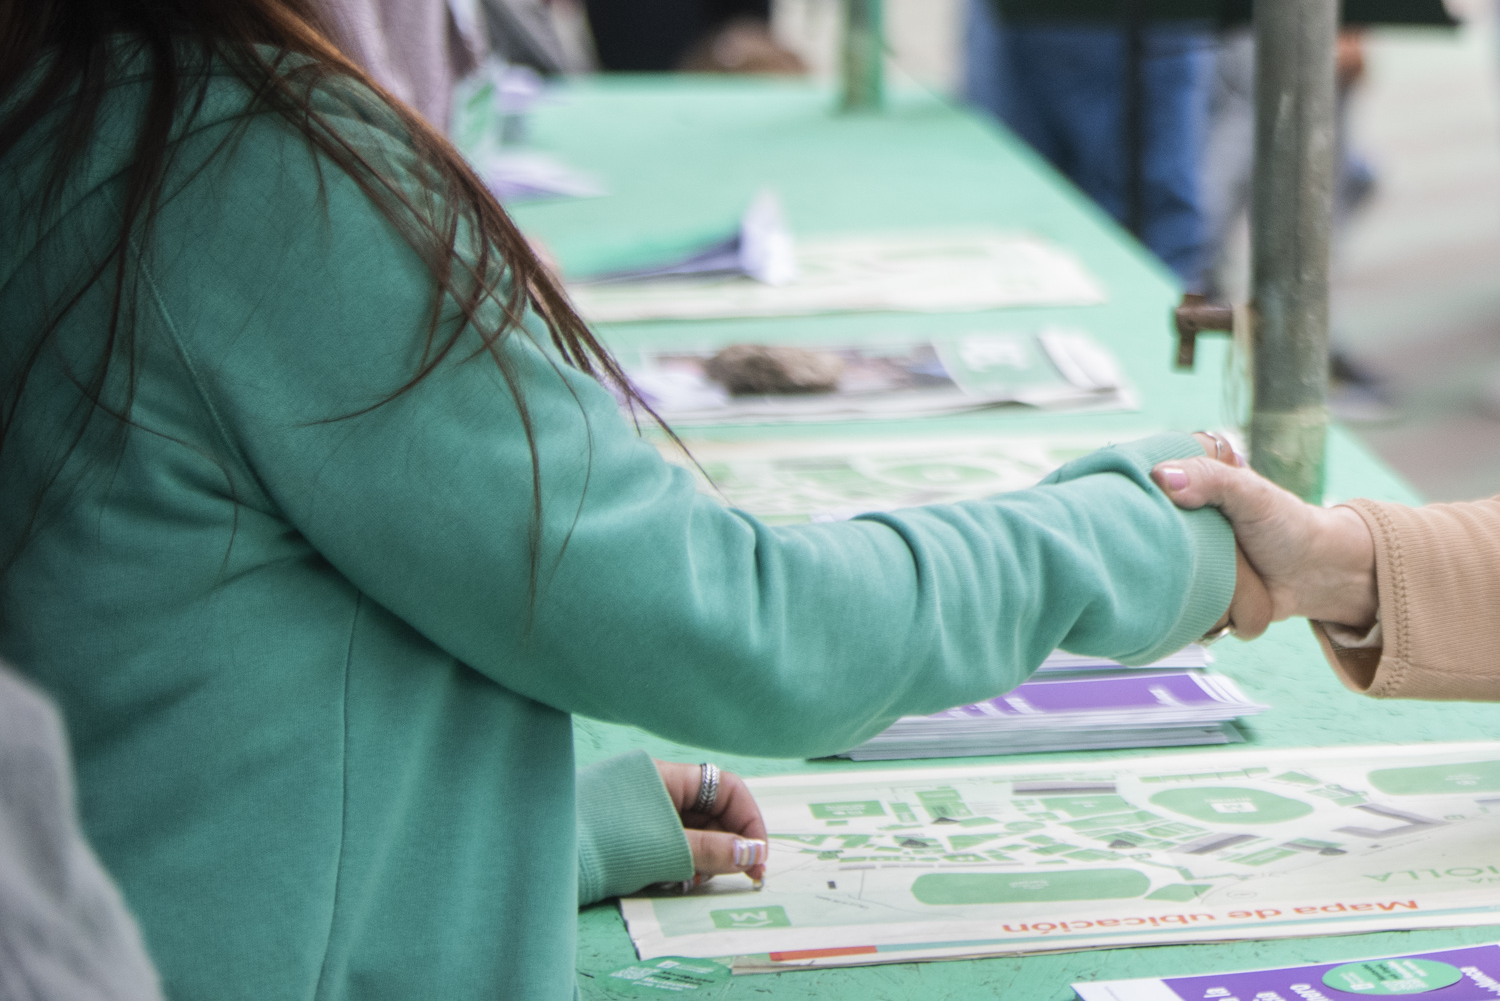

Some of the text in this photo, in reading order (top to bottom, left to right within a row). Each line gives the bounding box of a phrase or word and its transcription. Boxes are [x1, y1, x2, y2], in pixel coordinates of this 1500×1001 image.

[1001, 900, 1420, 935] Mapa de ubicación
